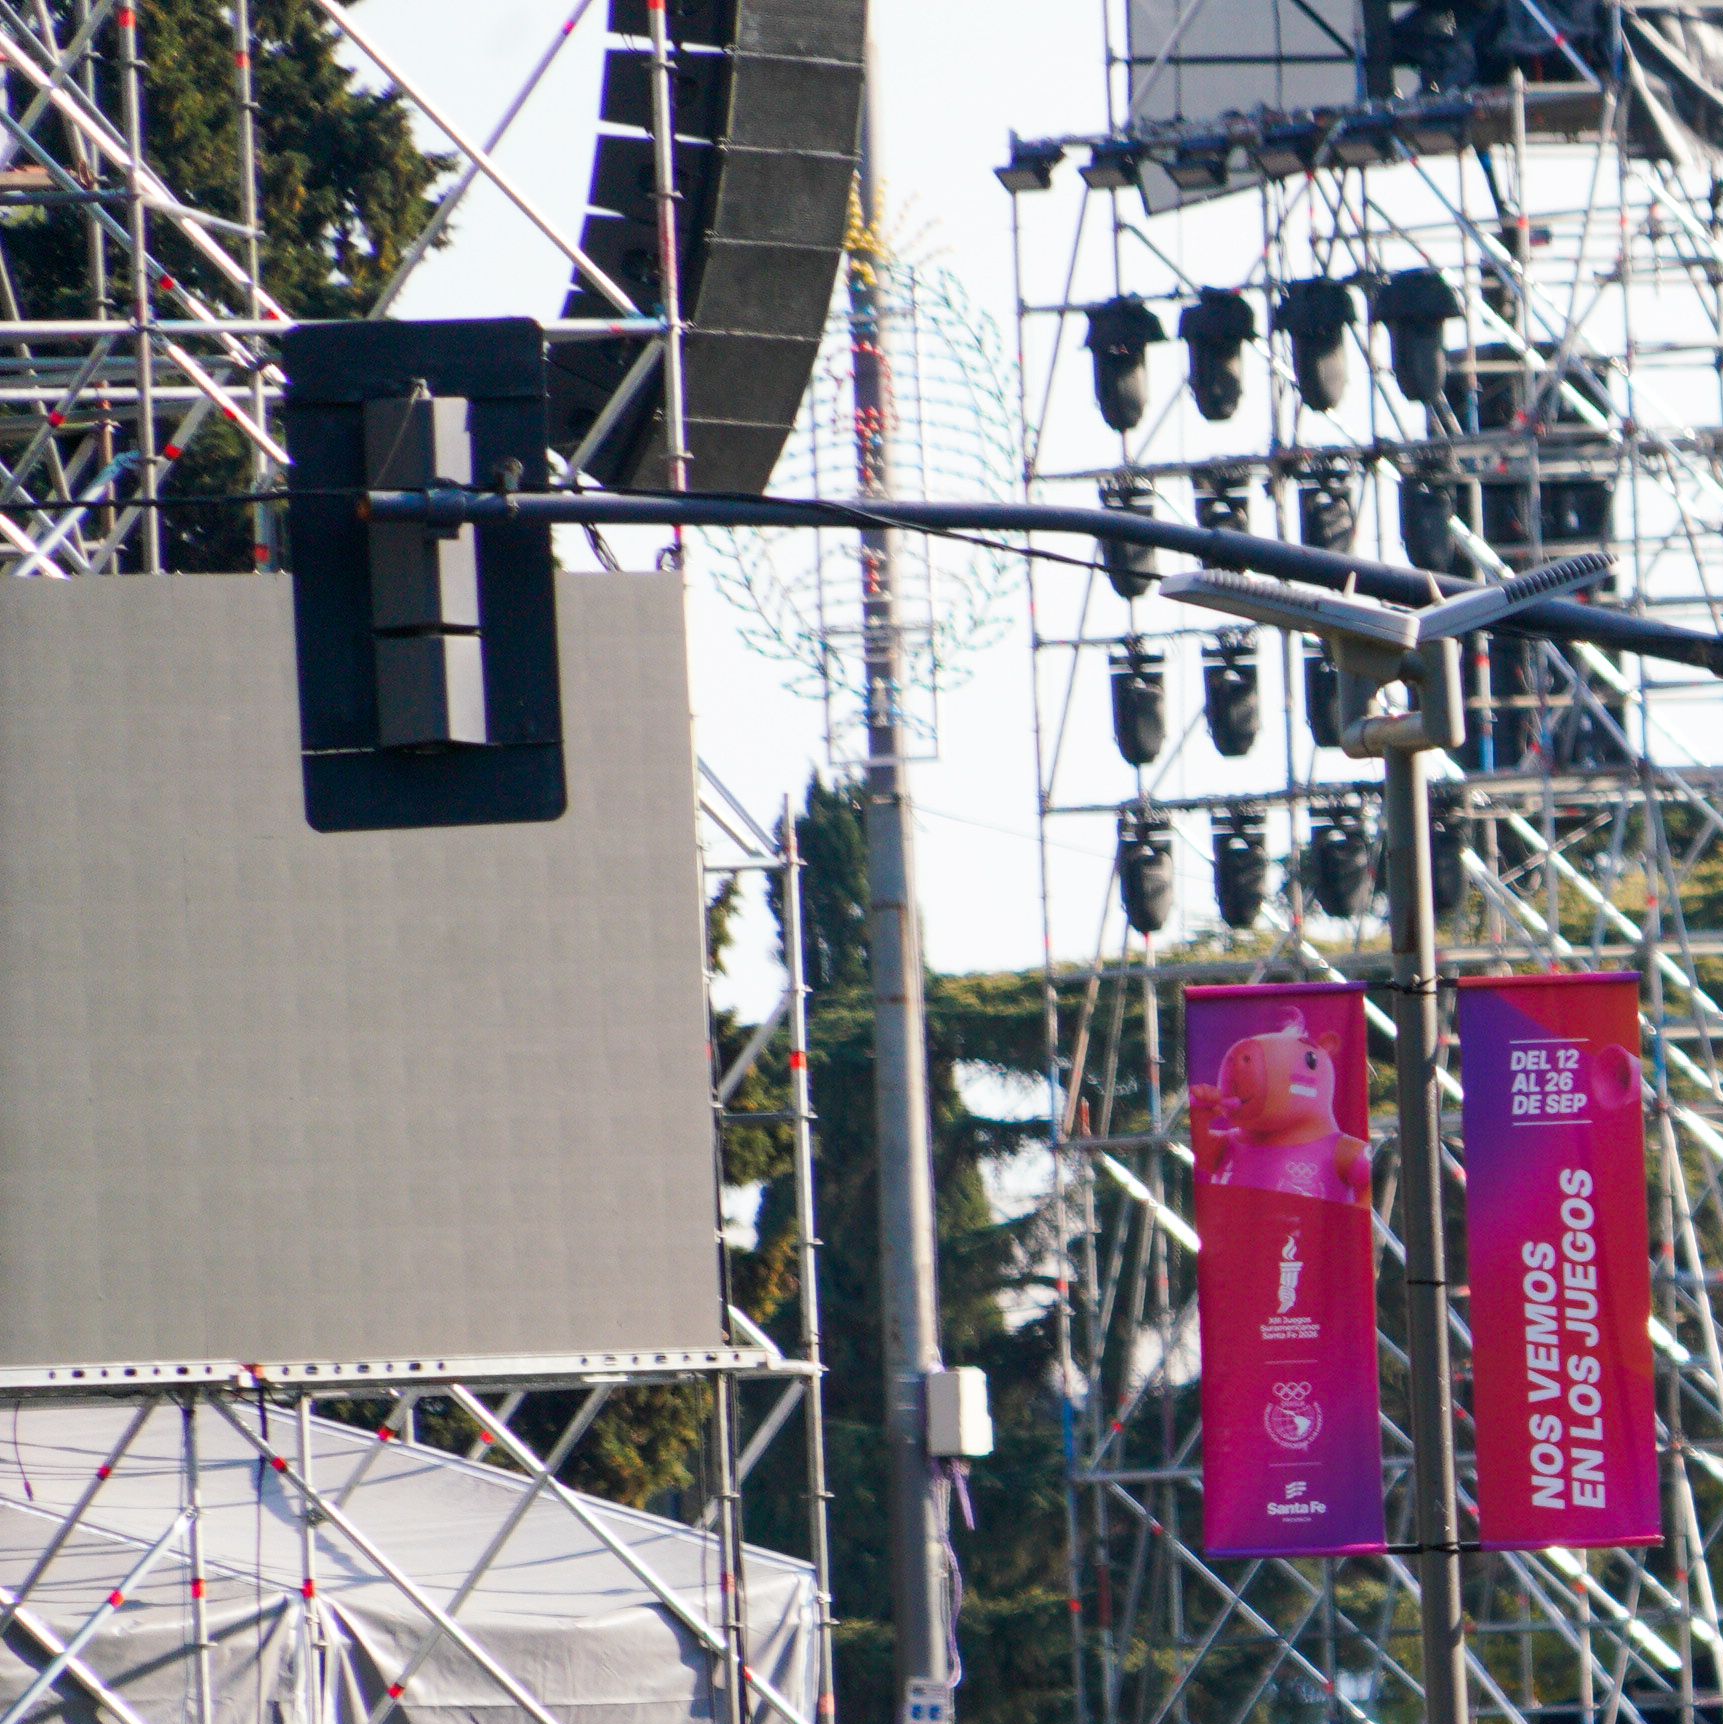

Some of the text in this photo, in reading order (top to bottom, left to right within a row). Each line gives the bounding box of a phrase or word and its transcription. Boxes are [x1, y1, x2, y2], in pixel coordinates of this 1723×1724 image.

[1510, 1048, 1580, 1071] DEL 12
[1511, 1070, 1574, 1093] AL 26
[1511, 1092, 1588, 1116] DE SEP
[1559, 1168, 1606, 1509] EN LOS JUEGOS
[1521, 1240, 1566, 1510] NOS VEMOS
[1266, 1500, 1327, 1516] Santa Fe
